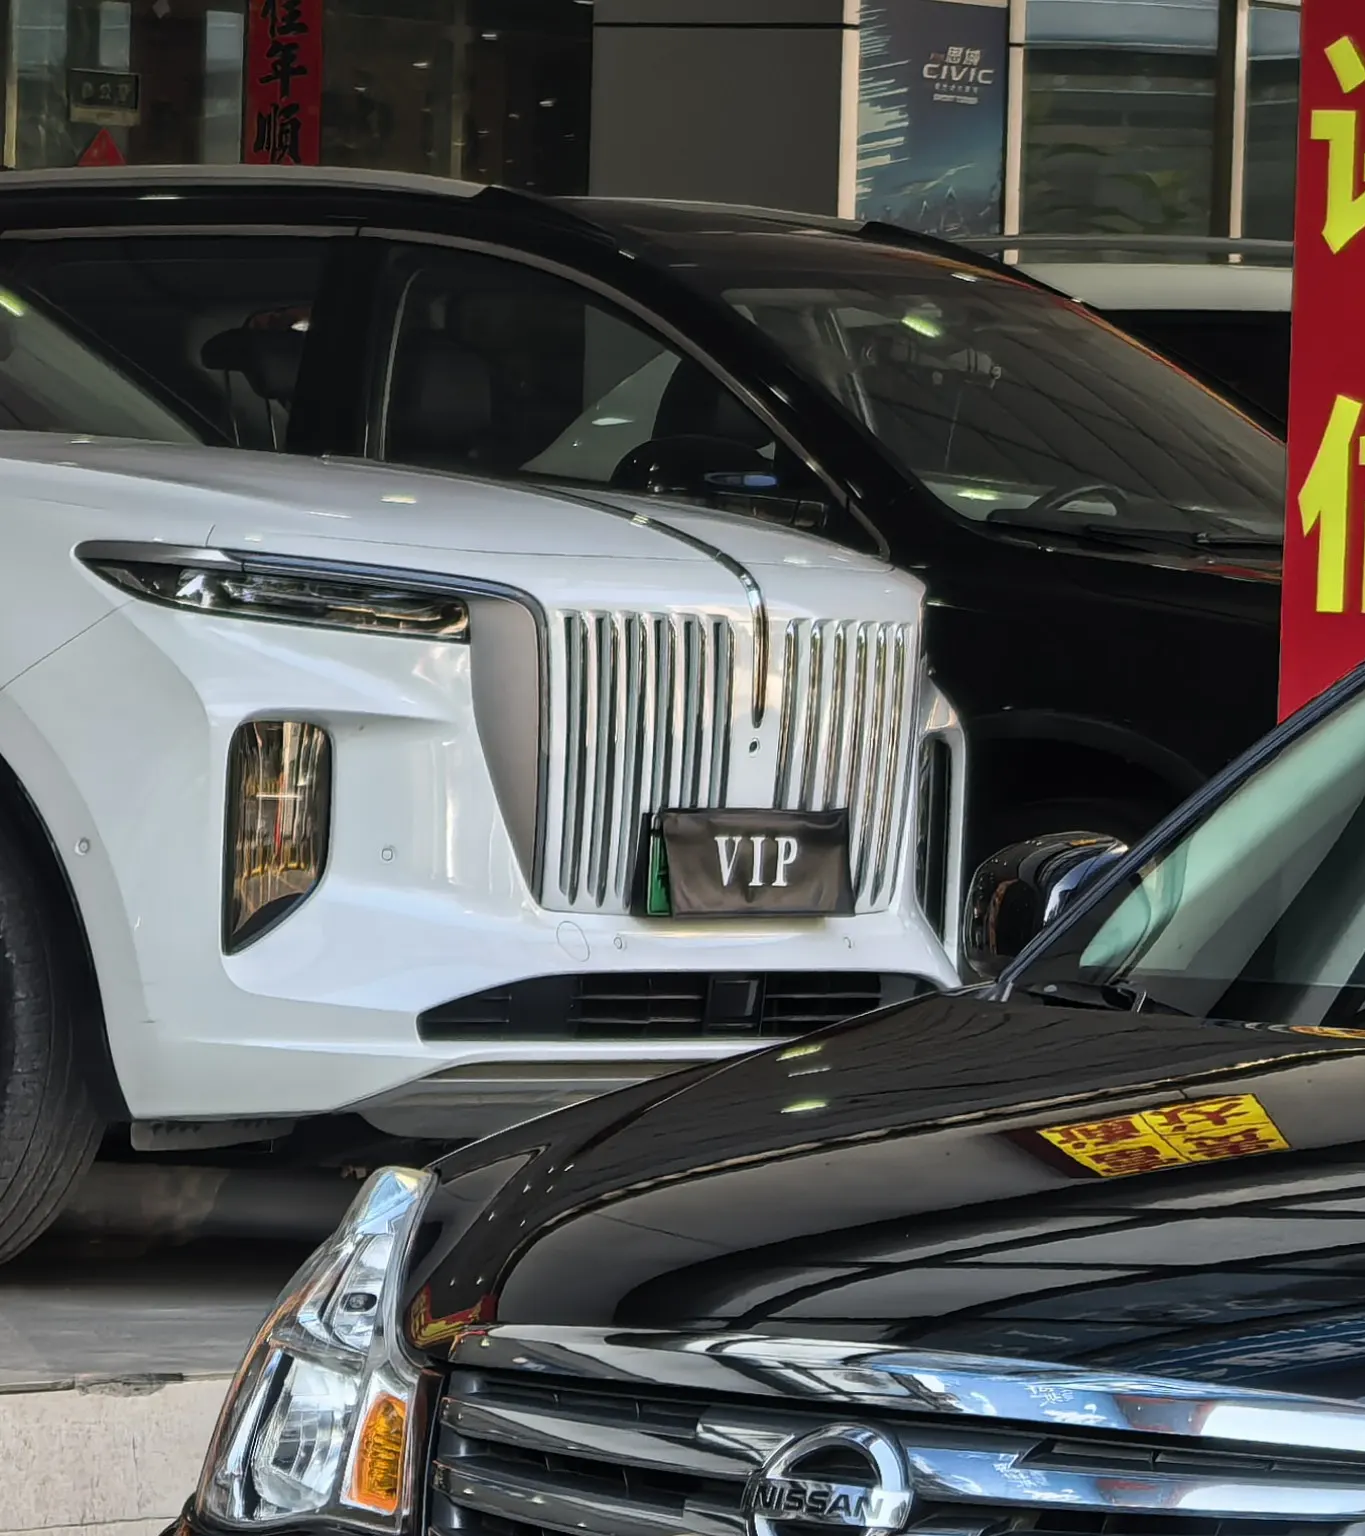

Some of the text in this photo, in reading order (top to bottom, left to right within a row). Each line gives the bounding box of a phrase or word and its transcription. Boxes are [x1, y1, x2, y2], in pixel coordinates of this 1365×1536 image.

[922, 63, 994, 85] CIVIC
[714, 835, 799, 888] VIP
[753, 1483, 884, 1521] NISSAN
